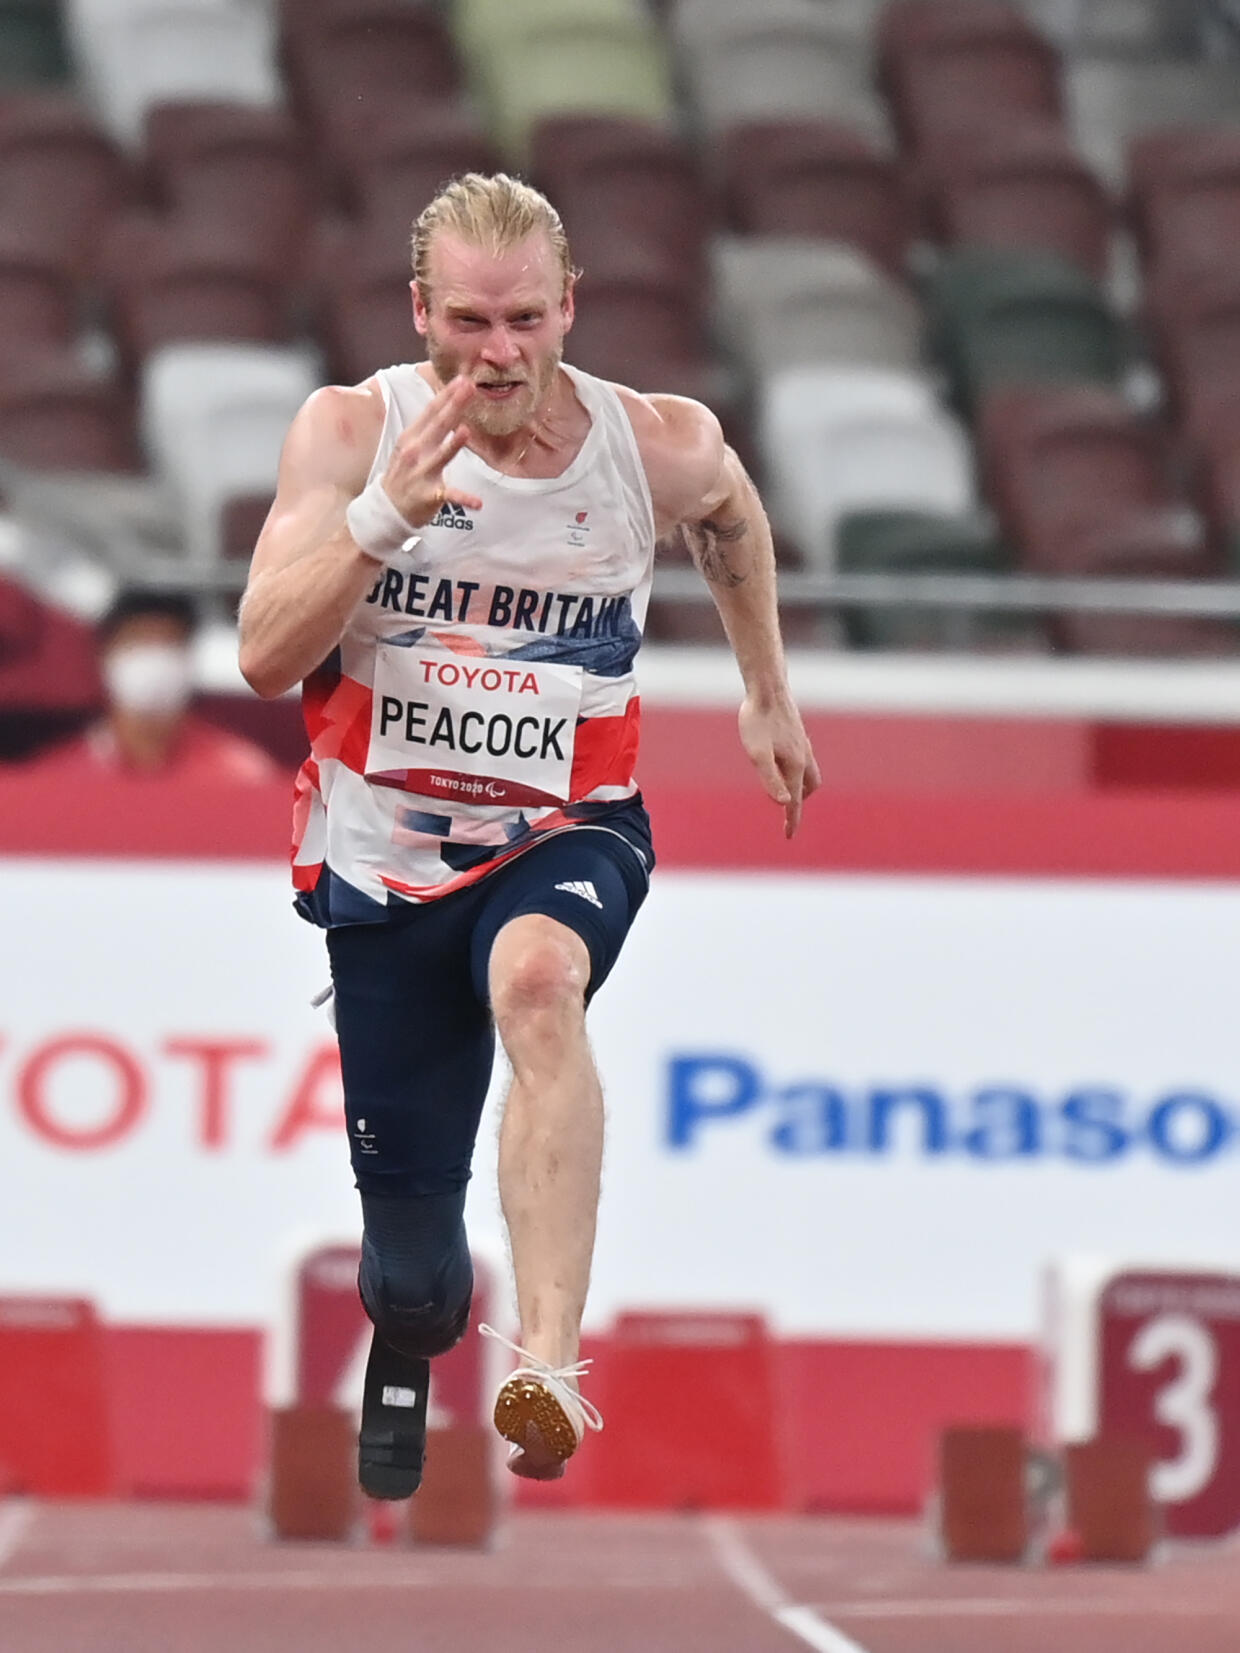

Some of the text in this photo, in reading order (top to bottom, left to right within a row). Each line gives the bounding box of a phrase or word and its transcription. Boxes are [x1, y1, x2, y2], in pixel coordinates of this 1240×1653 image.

[430, 514, 474, 531] didas
[488, 585, 627, 638] BRITAIN
[419, 660, 540, 695] TOYOTA
[379, 695, 567, 760] PEACOCK
[429, 774, 485, 794] TOKYO 2020
[664, 1052, 1239, 1166] Panaso
[1126, 1312, 1217, 1503] 3
